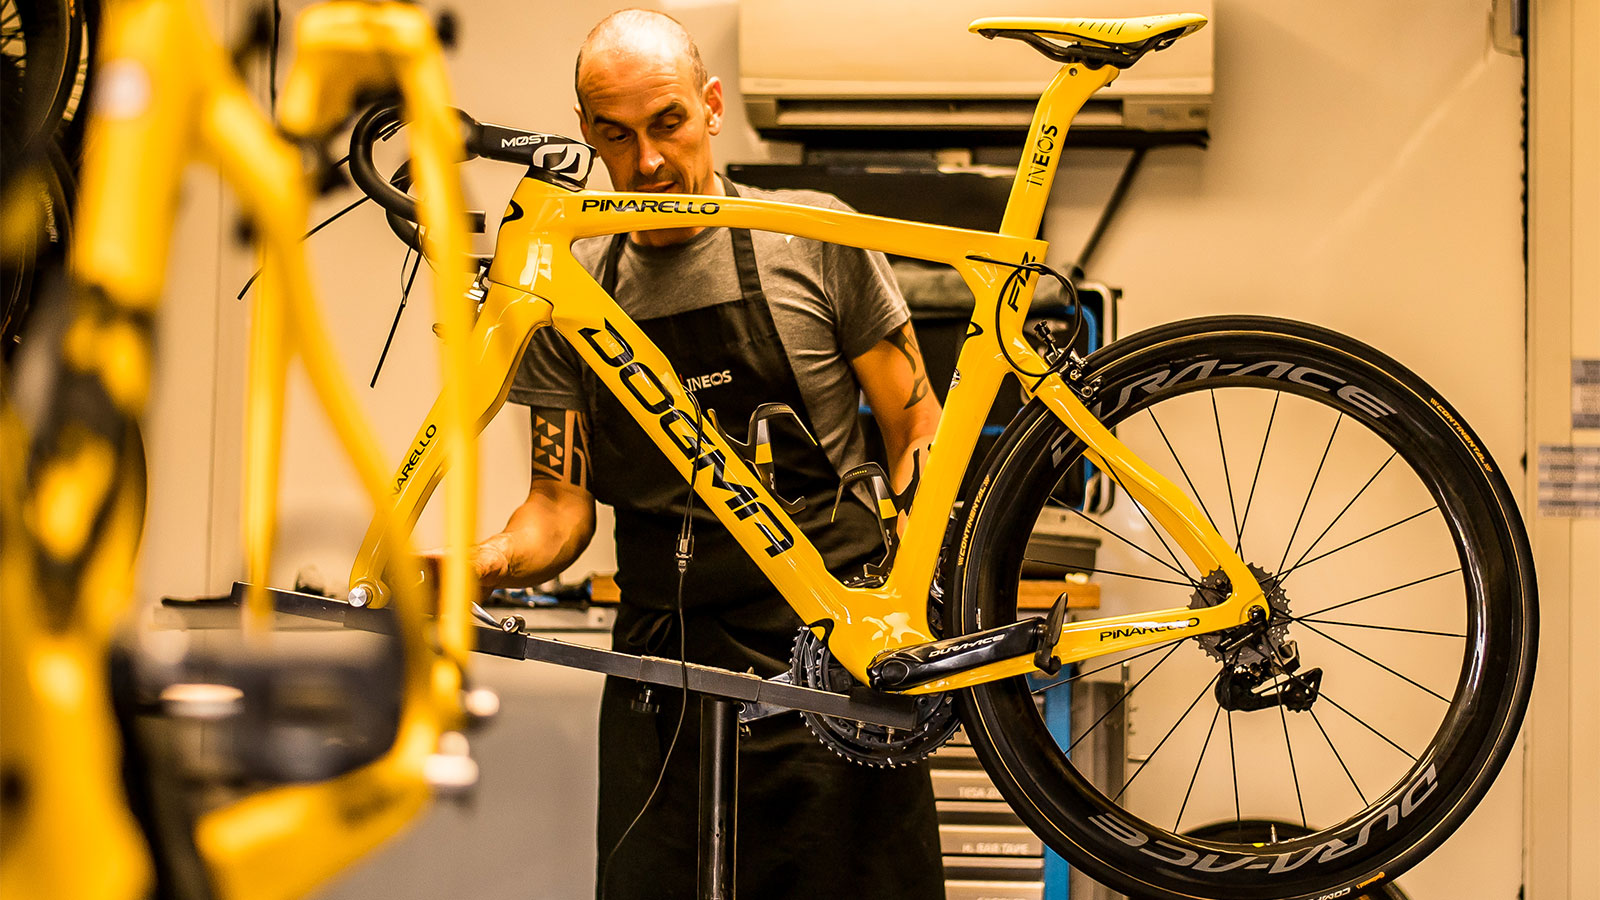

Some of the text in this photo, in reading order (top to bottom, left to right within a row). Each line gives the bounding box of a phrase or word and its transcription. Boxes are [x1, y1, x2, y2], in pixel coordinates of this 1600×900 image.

[1026, 124, 1058, 187] INEOS
[686, 369, 732, 392] INEOS
[577, 317, 795, 558] DOGMA
[1436, 404, 1485, 464] CONTINENTAL
[959, 486, 987, 559] CONTINENTAL
[1088, 763, 1438, 874] DURA-ACE
